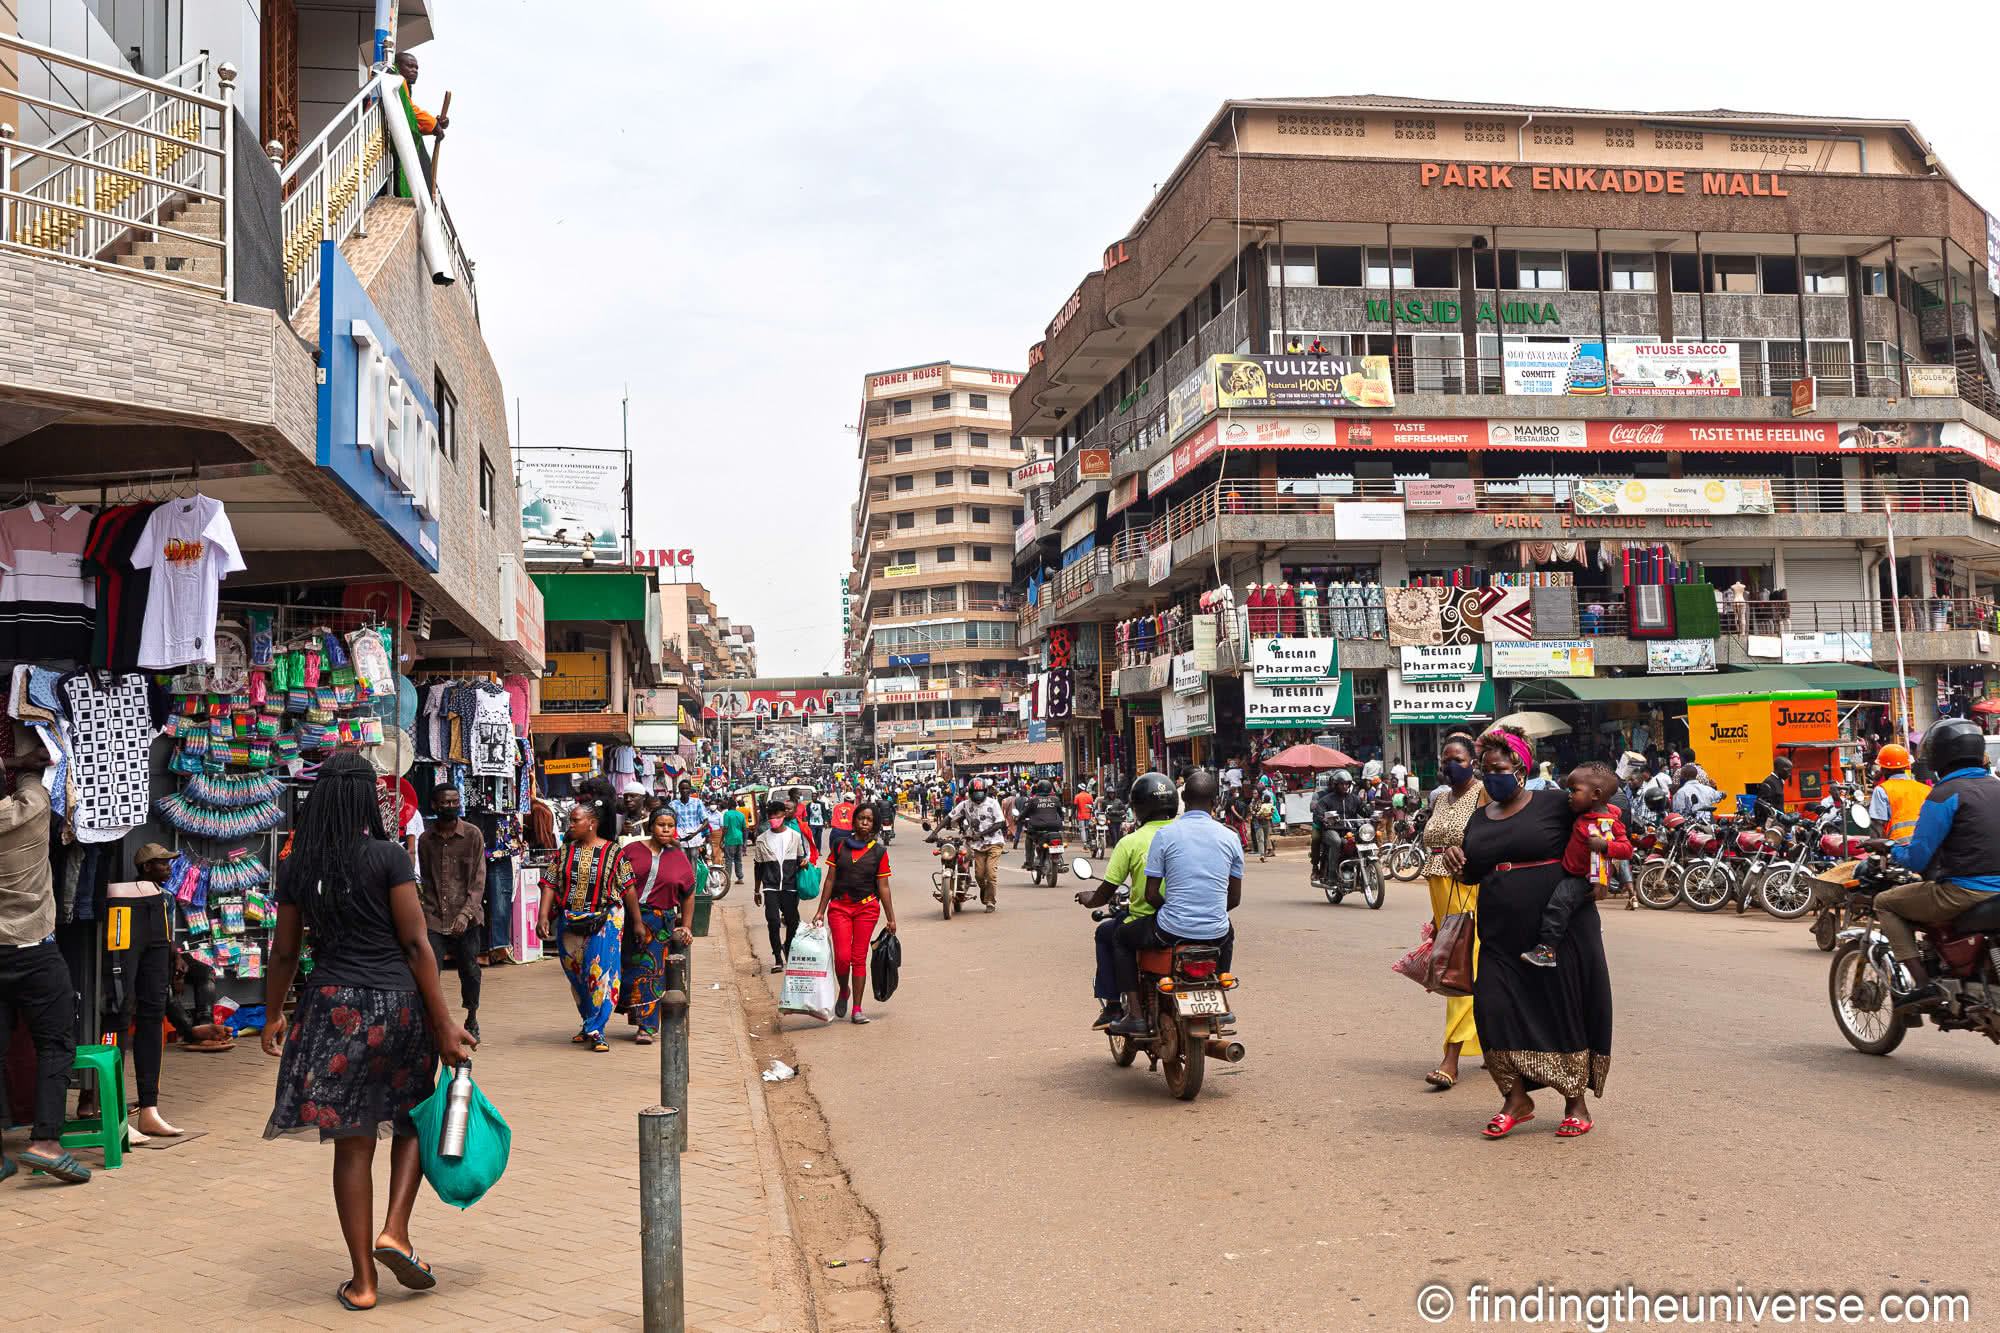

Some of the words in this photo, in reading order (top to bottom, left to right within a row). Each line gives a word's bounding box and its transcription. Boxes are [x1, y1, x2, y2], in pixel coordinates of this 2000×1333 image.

[1421, 163, 1513, 189] PARK
[1532, 167, 1685, 195] ENKADDE
[1702, 172, 1788, 197] MALL
[1052, 288, 1081, 338] ENKADDE
[1366, 299, 1462, 324] MASJID
[1477, 301, 1560, 325] AMINA
[1636, 345, 1684, 355] NTUUSE
[1687, 345, 1727, 355] SACCO
[1263, 360, 1352, 376] TULIZENI
[873, 373, 908, 388] CORNER
[913, 367, 942, 381] HOUSE
[1521, 370, 1556, 378] COMMITTE
[1918, 374, 1948, 382] GOLDEN
[1268, 381, 1298, 390] Natural
[1299, 378, 1339, 392] HONEY
[1393, 423, 1425, 432] TASTE
[1513, 425, 1560, 436] MAMBO
[1394, 434, 1469, 443] REFRESHMENT
[1514, 435, 1560, 443] RESTAURANT
[1609, 424, 1666, 445] Coca-Cola
[1689, 427, 1733, 441] TASTE
[1735, 428, 1763, 442] THE
[1766, 428, 1825, 442] FEELING
[1673, 487, 1697, 495] Catering
[1493, 514, 1543, 528] PARK
[1561, 514, 1647, 528] ENKADDE
[1664, 515, 1713, 528] MALL
[1494, 641, 1540, 649] KANYAMUHE
[1541, 640, 1592, 648] INVESTMENTS
[1256, 664, 1329, 674] Pharmacy
[1403, 662, 1474, 671] Pharmacy
[1175, 675, 1201, 688] Pharmacy
[1249, 704, 1331, 714] Pharmacy
[1393, 700, 1473, 710] Pharmacy
[712, 779, 722, 788] 30
[1193, 991, 1217, 1001] UFB
